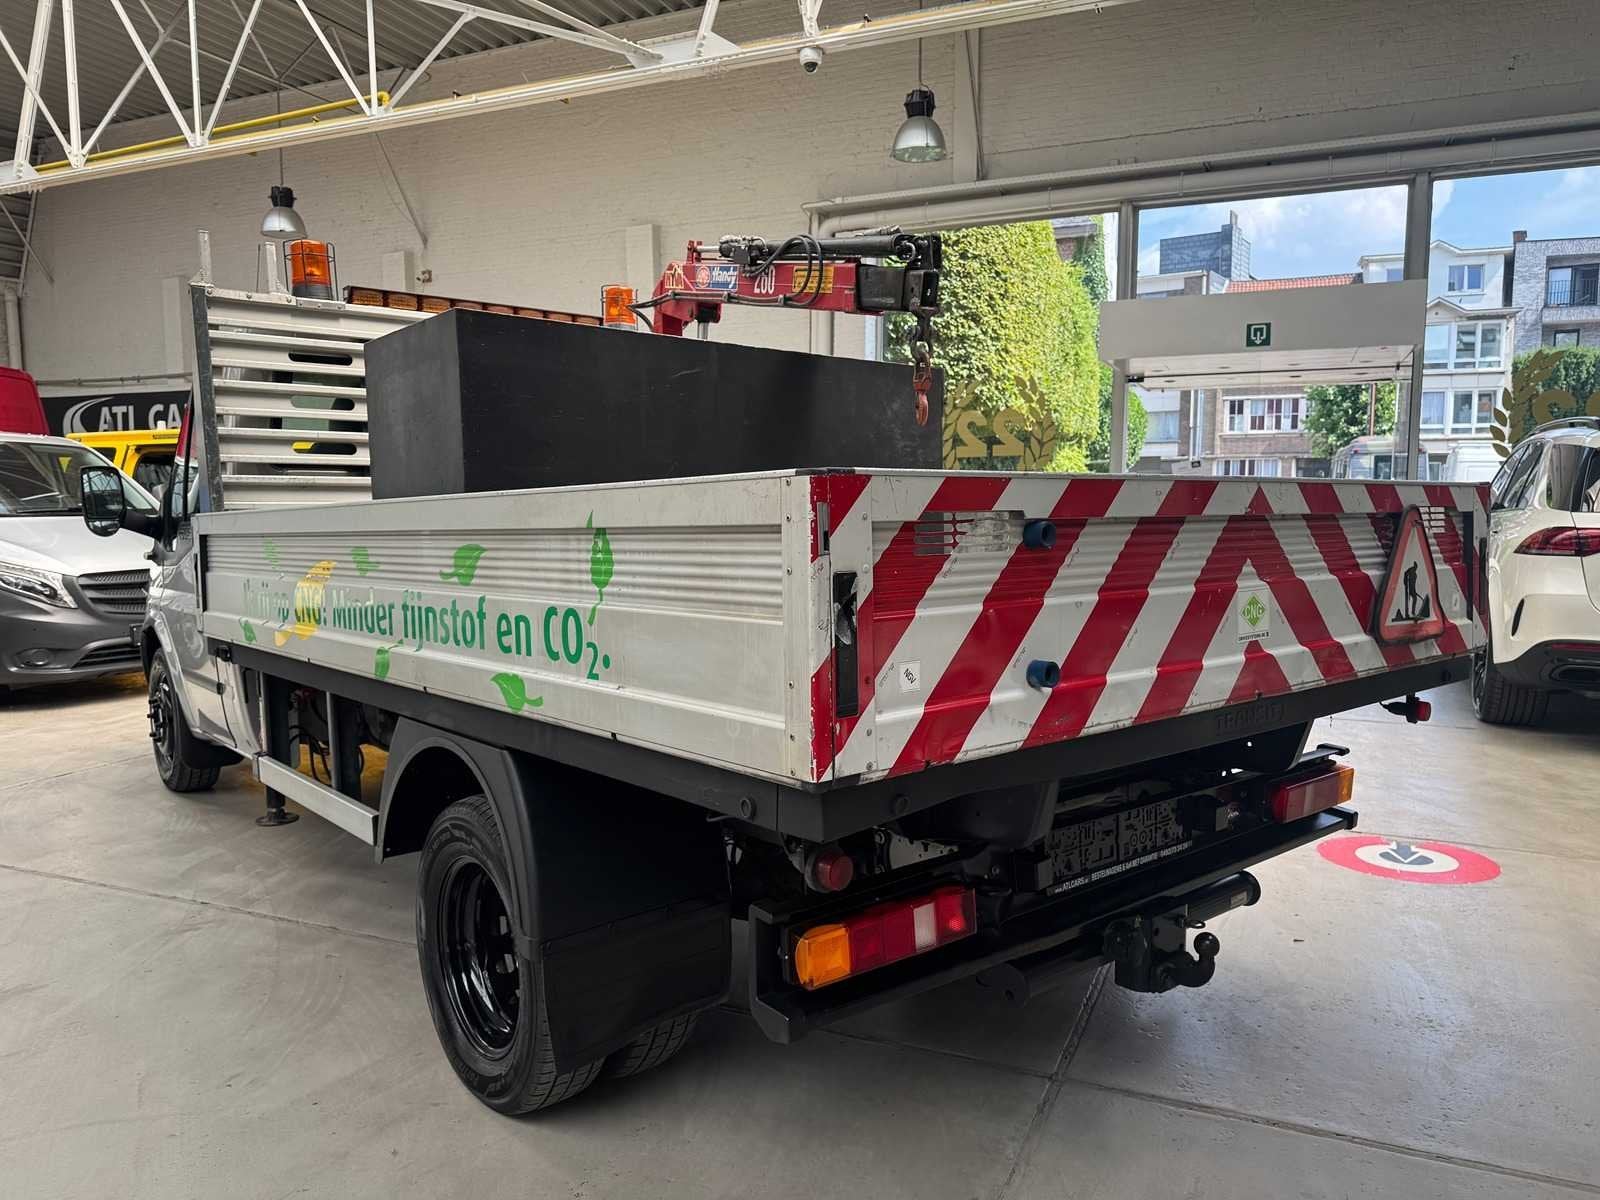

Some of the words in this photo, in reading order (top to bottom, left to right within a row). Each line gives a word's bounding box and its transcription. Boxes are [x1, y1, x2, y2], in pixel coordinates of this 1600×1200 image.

[712, 267, 737, 289] Handy
[332, 587, 395, 637] Minder
[402, 589, 487, 652] fijnstof
[496, 613, 533, 657] en
